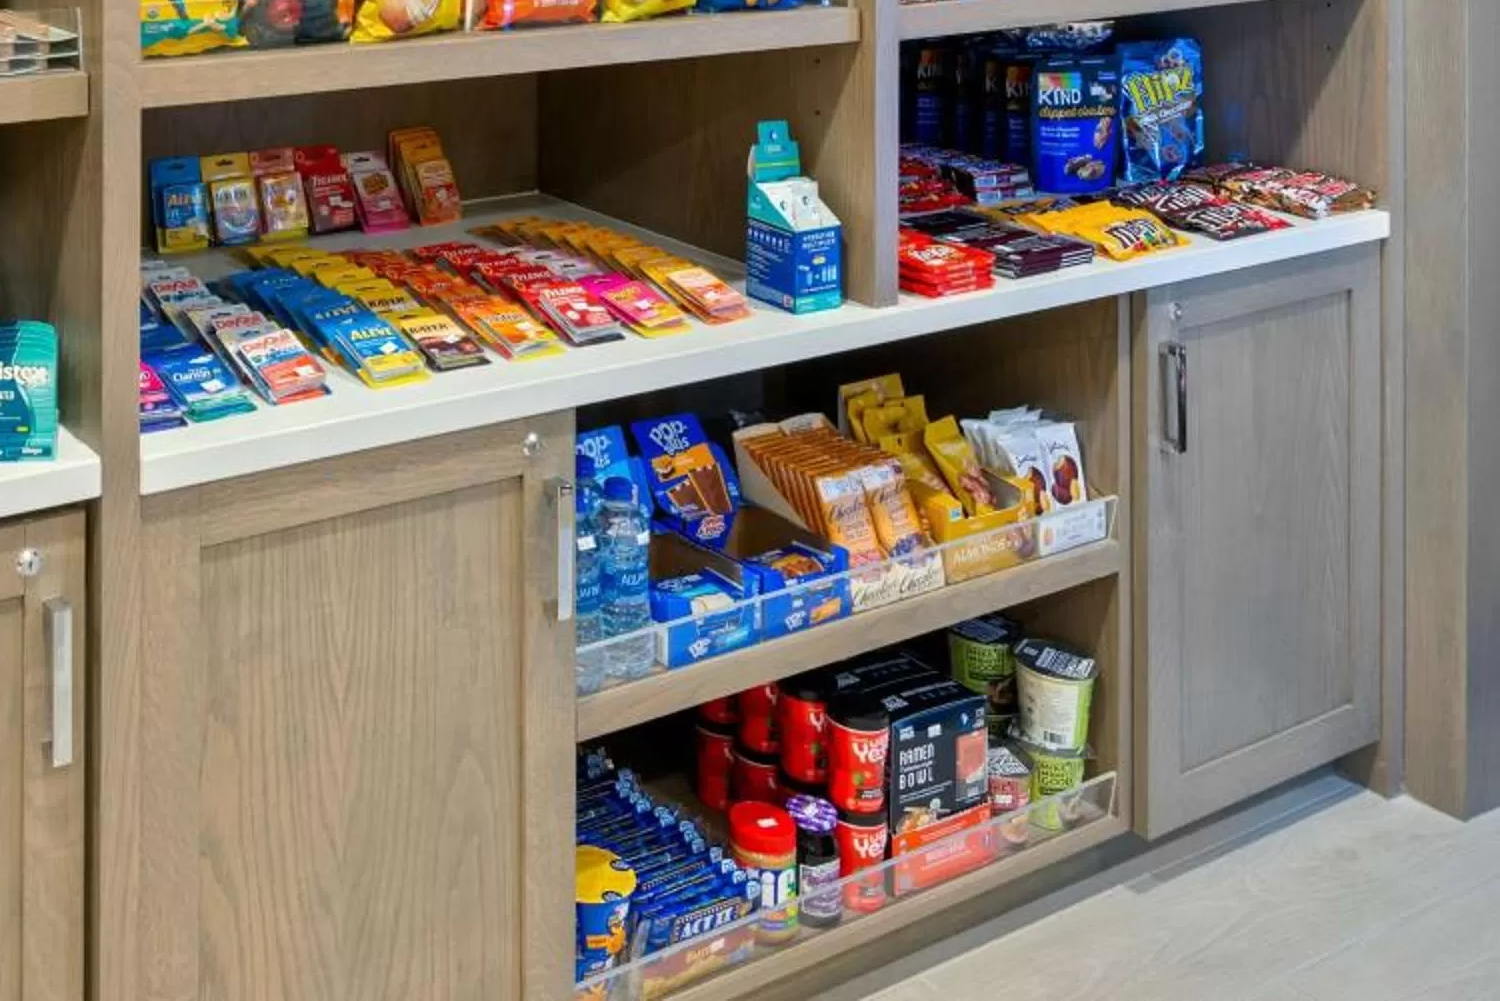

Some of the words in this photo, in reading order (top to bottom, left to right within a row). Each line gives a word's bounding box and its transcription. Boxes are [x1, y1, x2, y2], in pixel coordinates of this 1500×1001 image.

[1038, 89, 1081, 106] KIND
[899, 743, 935, 766] RAMEN
[898, 766, 934, 790] BOWL
[680, 917, 715, 941] ACT
